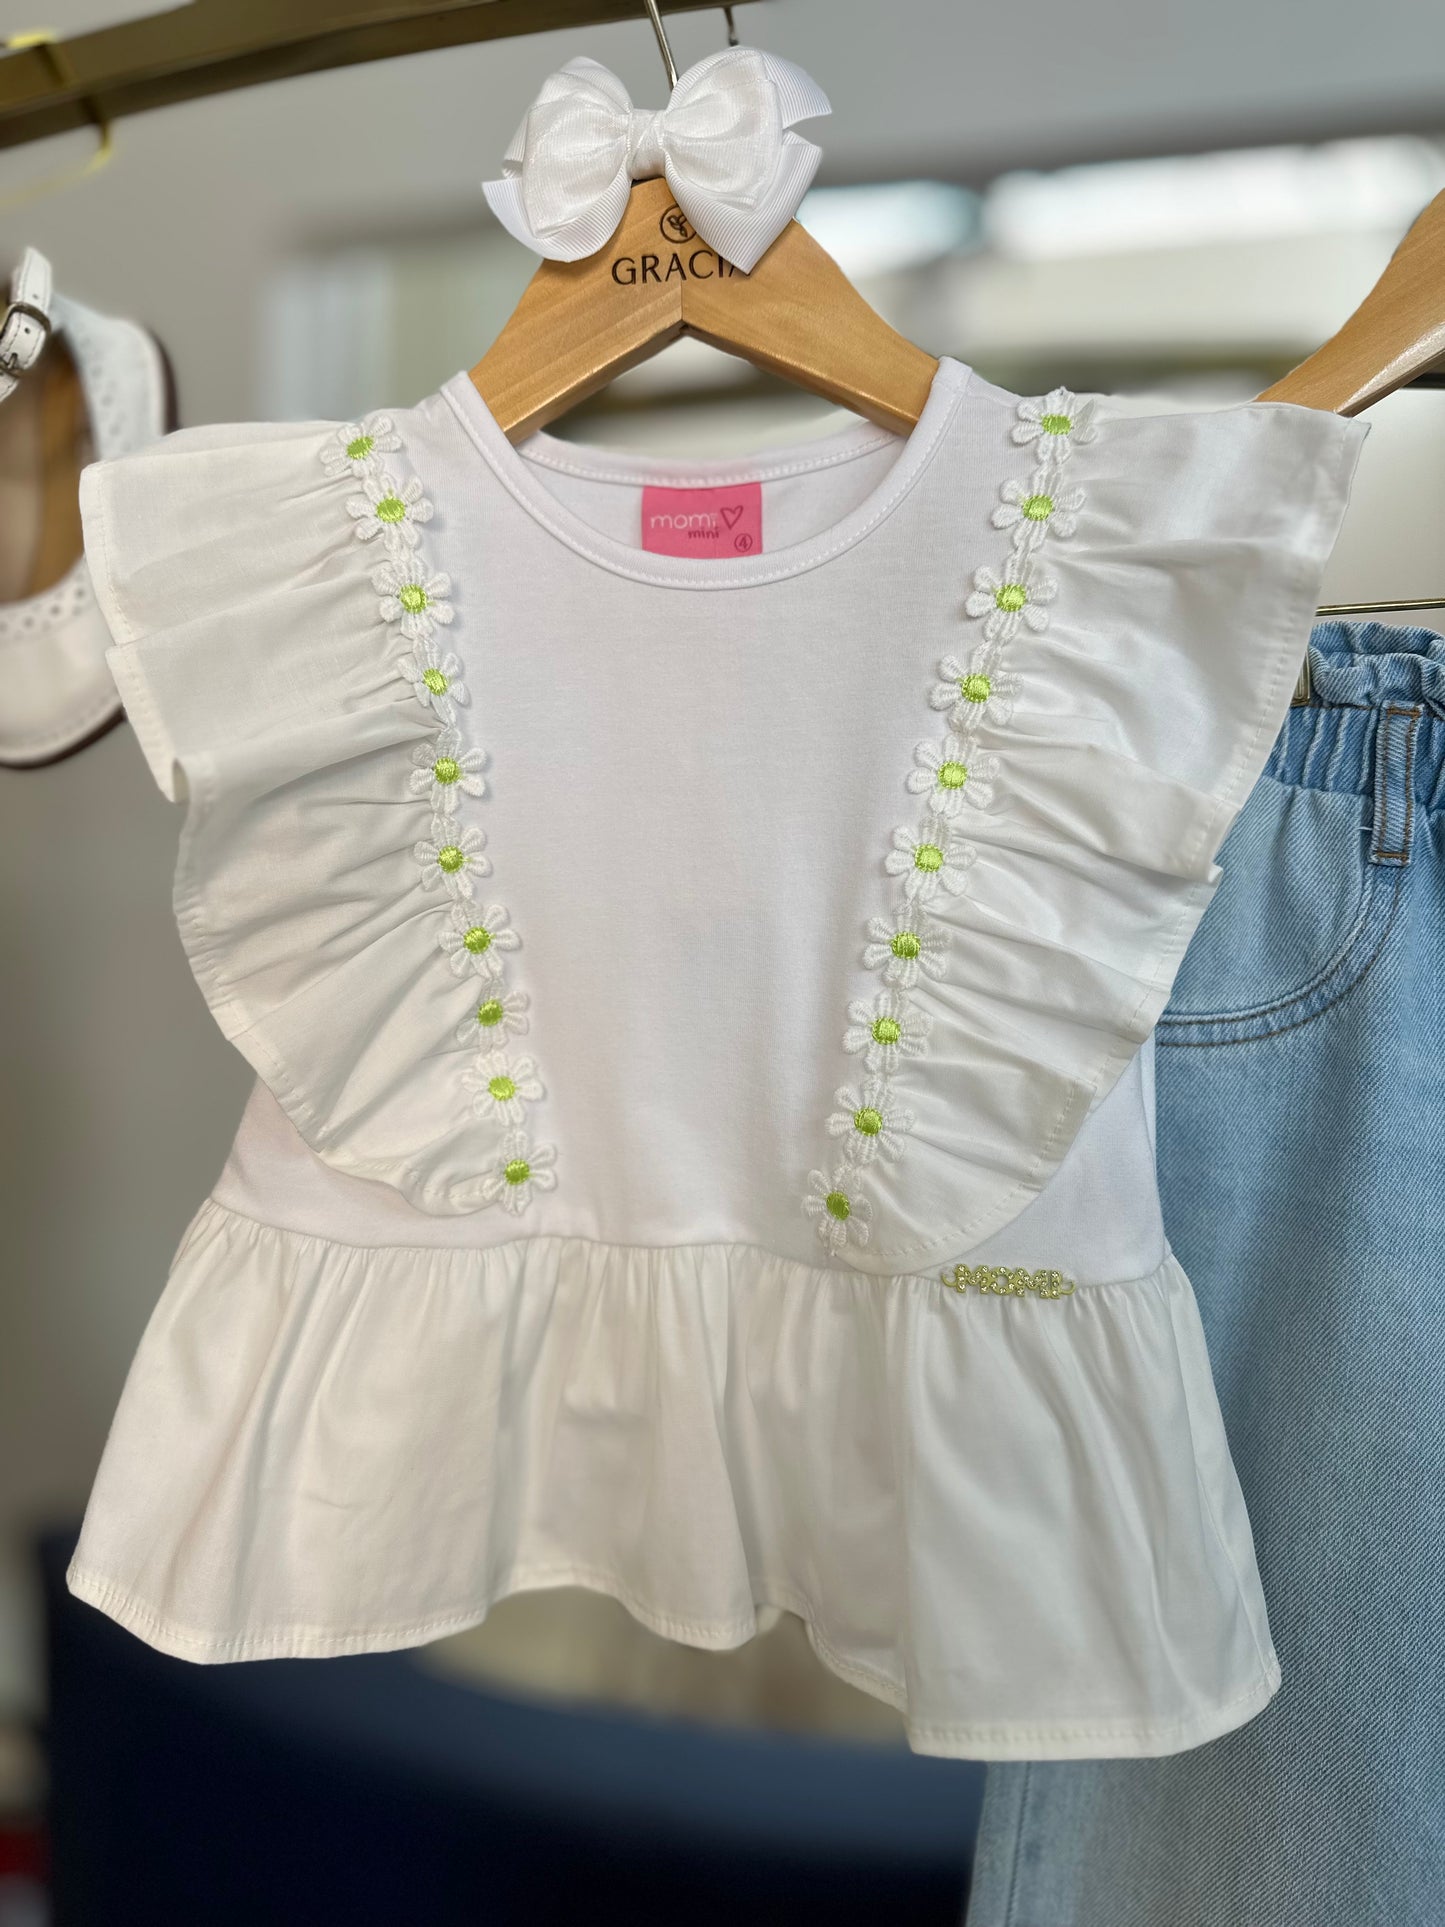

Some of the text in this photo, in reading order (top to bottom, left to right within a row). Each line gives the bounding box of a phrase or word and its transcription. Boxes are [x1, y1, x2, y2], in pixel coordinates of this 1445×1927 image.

[611, 249, 740, 286] GRACI
[650, 512, 718, 530] momi
[688, 526, 720, 539] mini
[953, 1263, 1063, 1299] MOMI
